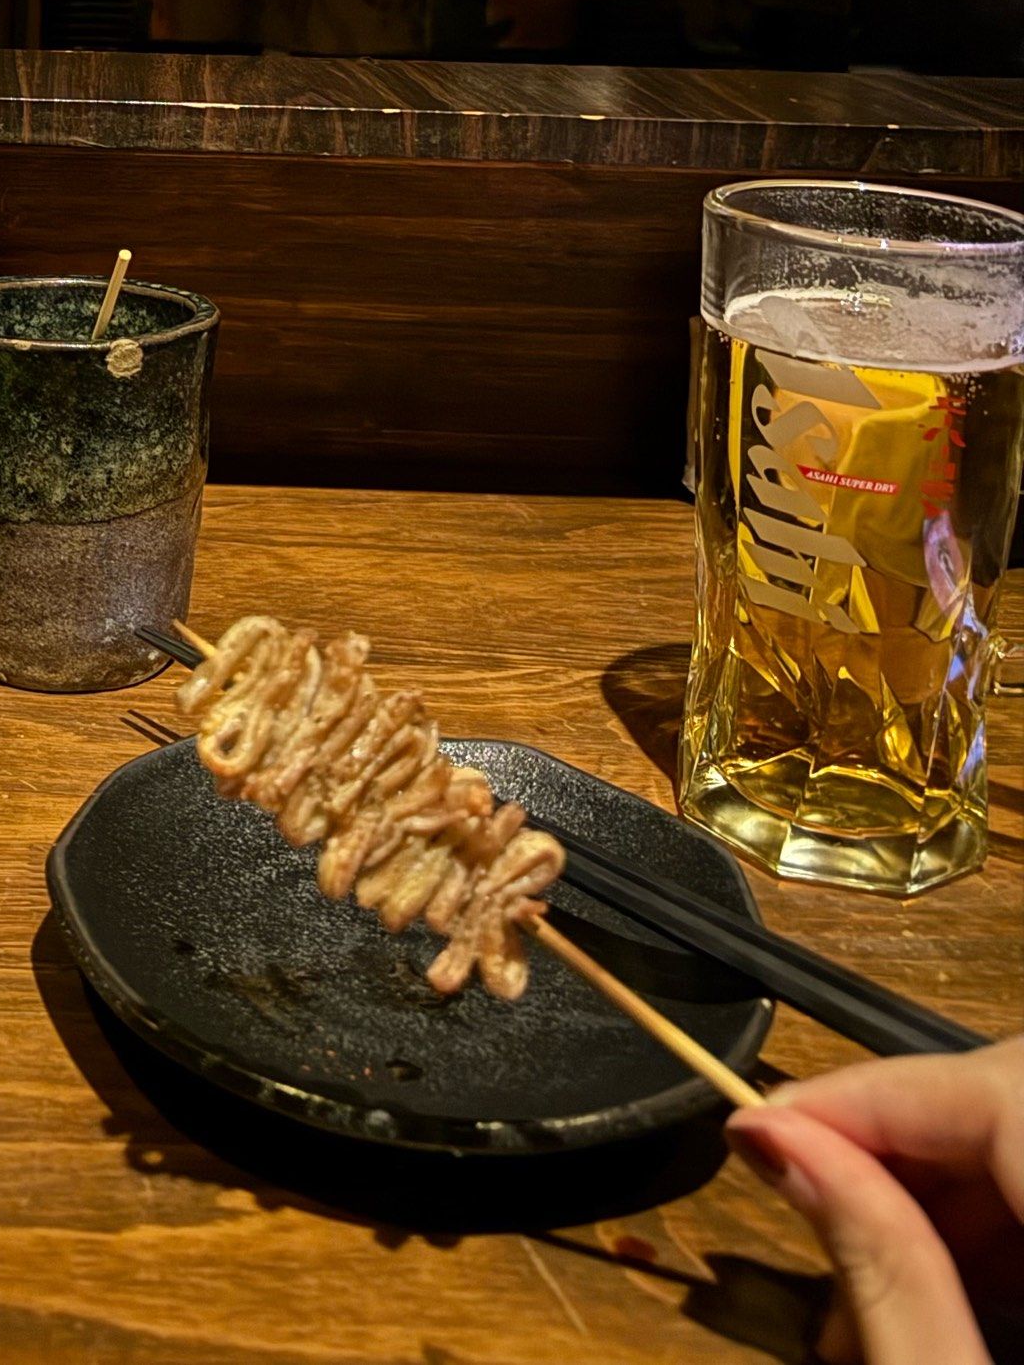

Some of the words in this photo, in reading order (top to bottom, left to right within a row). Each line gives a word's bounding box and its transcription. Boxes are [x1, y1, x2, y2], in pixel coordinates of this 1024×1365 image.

[805, 470, 838, 484] ASAHI
[838, 477, 873, 490] SUPER
[873, 482, 898, 493] DRY
